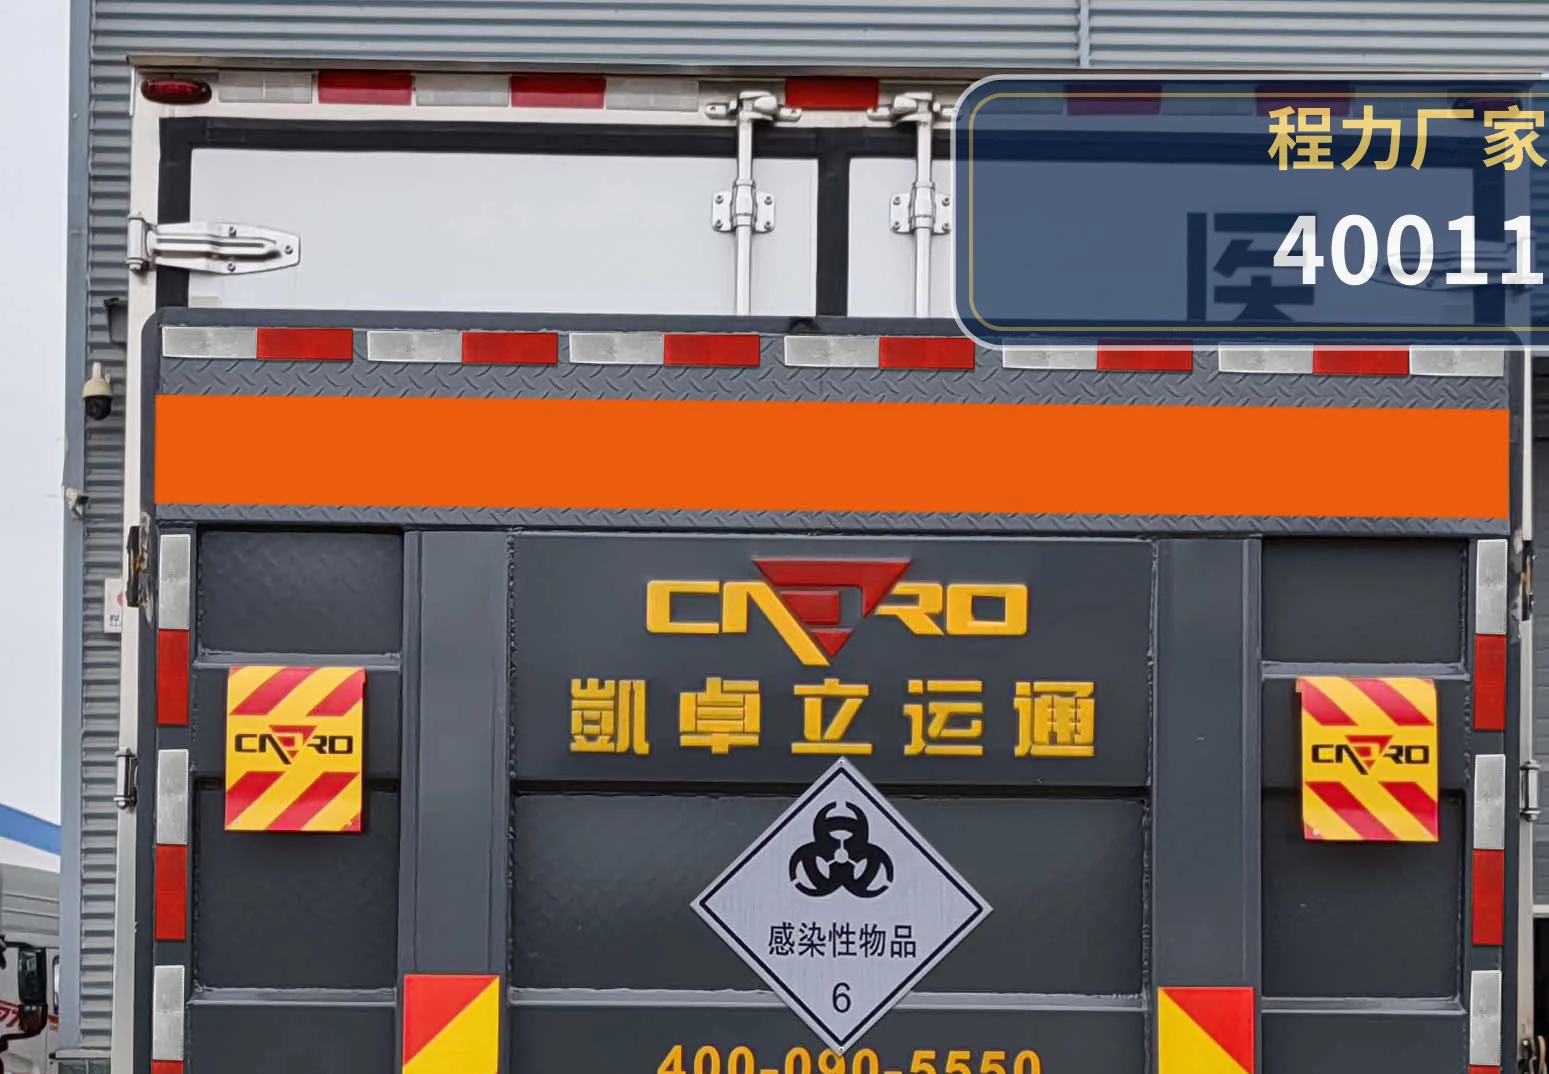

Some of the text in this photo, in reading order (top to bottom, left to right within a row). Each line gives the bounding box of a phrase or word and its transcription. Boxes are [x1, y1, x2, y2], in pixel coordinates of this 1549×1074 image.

[767, 922, 918, 959] 感染性物品
[832, 982, 852, 1014] 6
